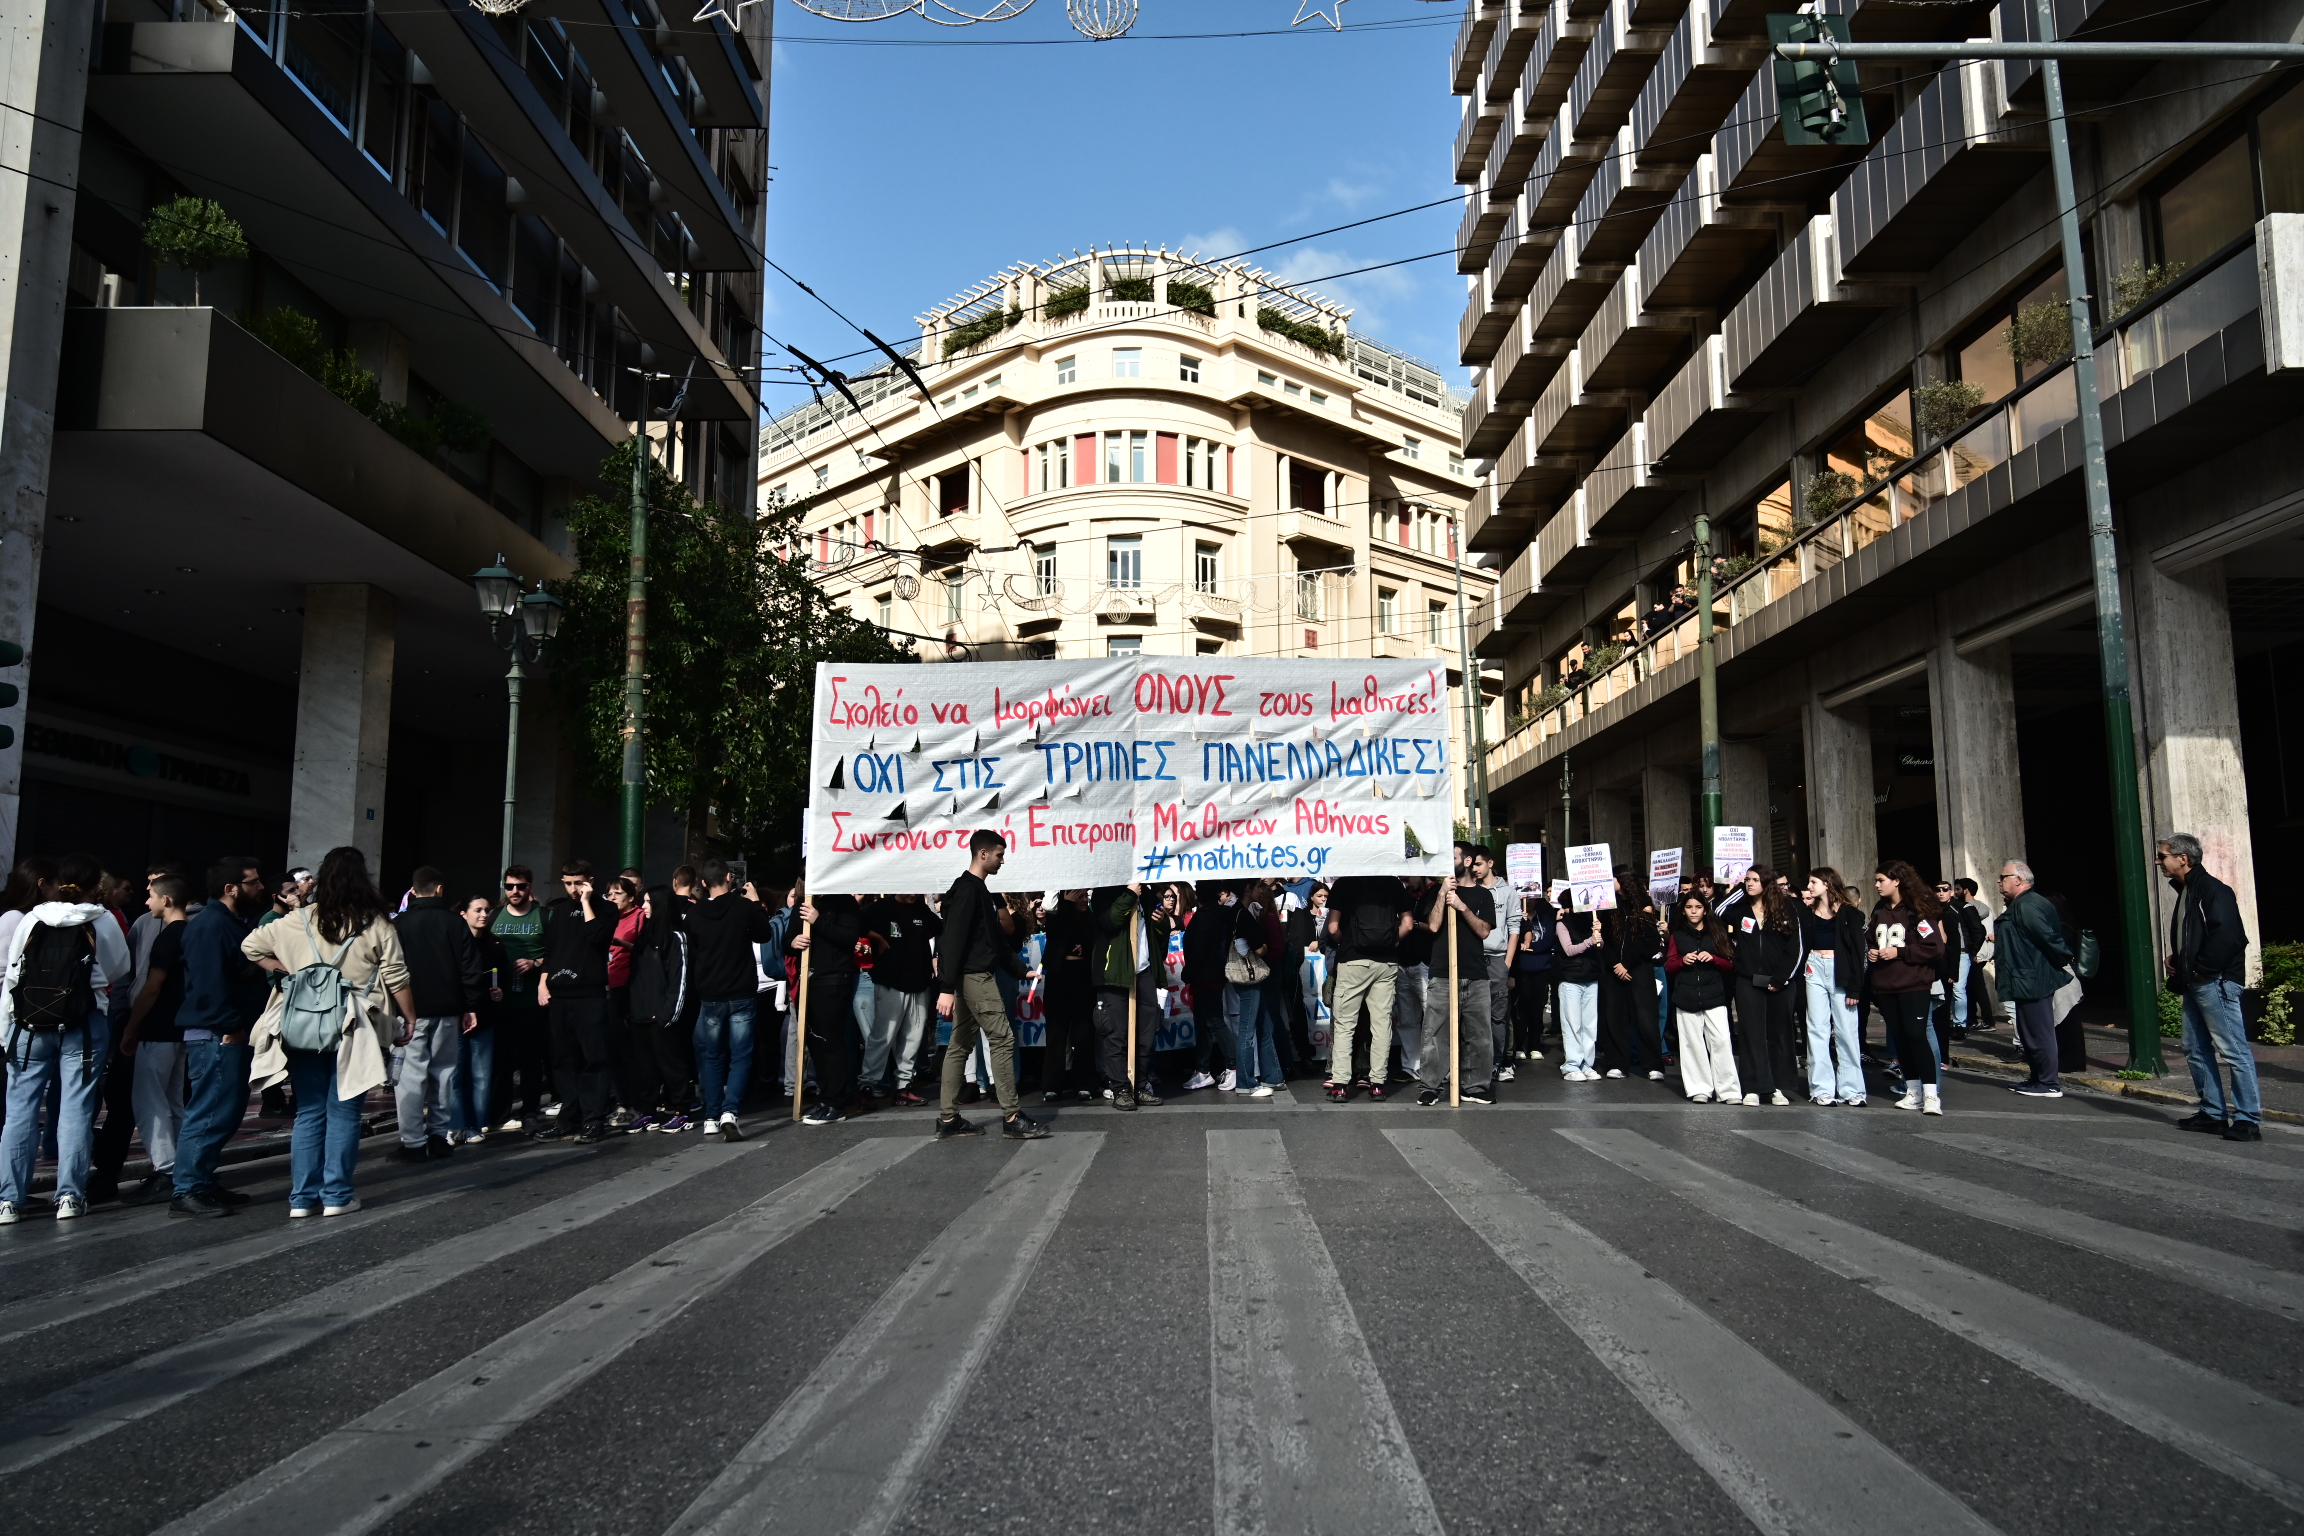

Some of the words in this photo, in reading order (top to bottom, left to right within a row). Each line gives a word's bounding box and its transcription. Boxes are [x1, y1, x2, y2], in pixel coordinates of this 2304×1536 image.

[829, 676, 918, 730] Σχολείο
[930, 702, 971, 725] να
[994, 684, 1113, 730] μορφώνει
[1135, 673, 1235, 717] ΟΛΟΥΣ
[1259, 691, 1313, 717] τους
[1330, 669, 1436, 723] μαθητές!
[853, 753, 905, 794] ΟΧΙ
[932, 756, 1006, 792] ΣΤΙΣ
[1034, 740, 1176, 785] ΤΡΙΠΛΕΣ
[1203, 737, 1444, 783] ΠΑΝΕΛΛΑΔΙΚΕΣ!
[831, 811, 1016, 853] Συντονιστή
[1028, 804, 1137, 853] Επιτροπή
[1153, 801, 1278, 842] Μαθητών
[1295, 797, 1390, 838] Αθήνας
[1136, 842, 1332, 881] #mathites.gr
